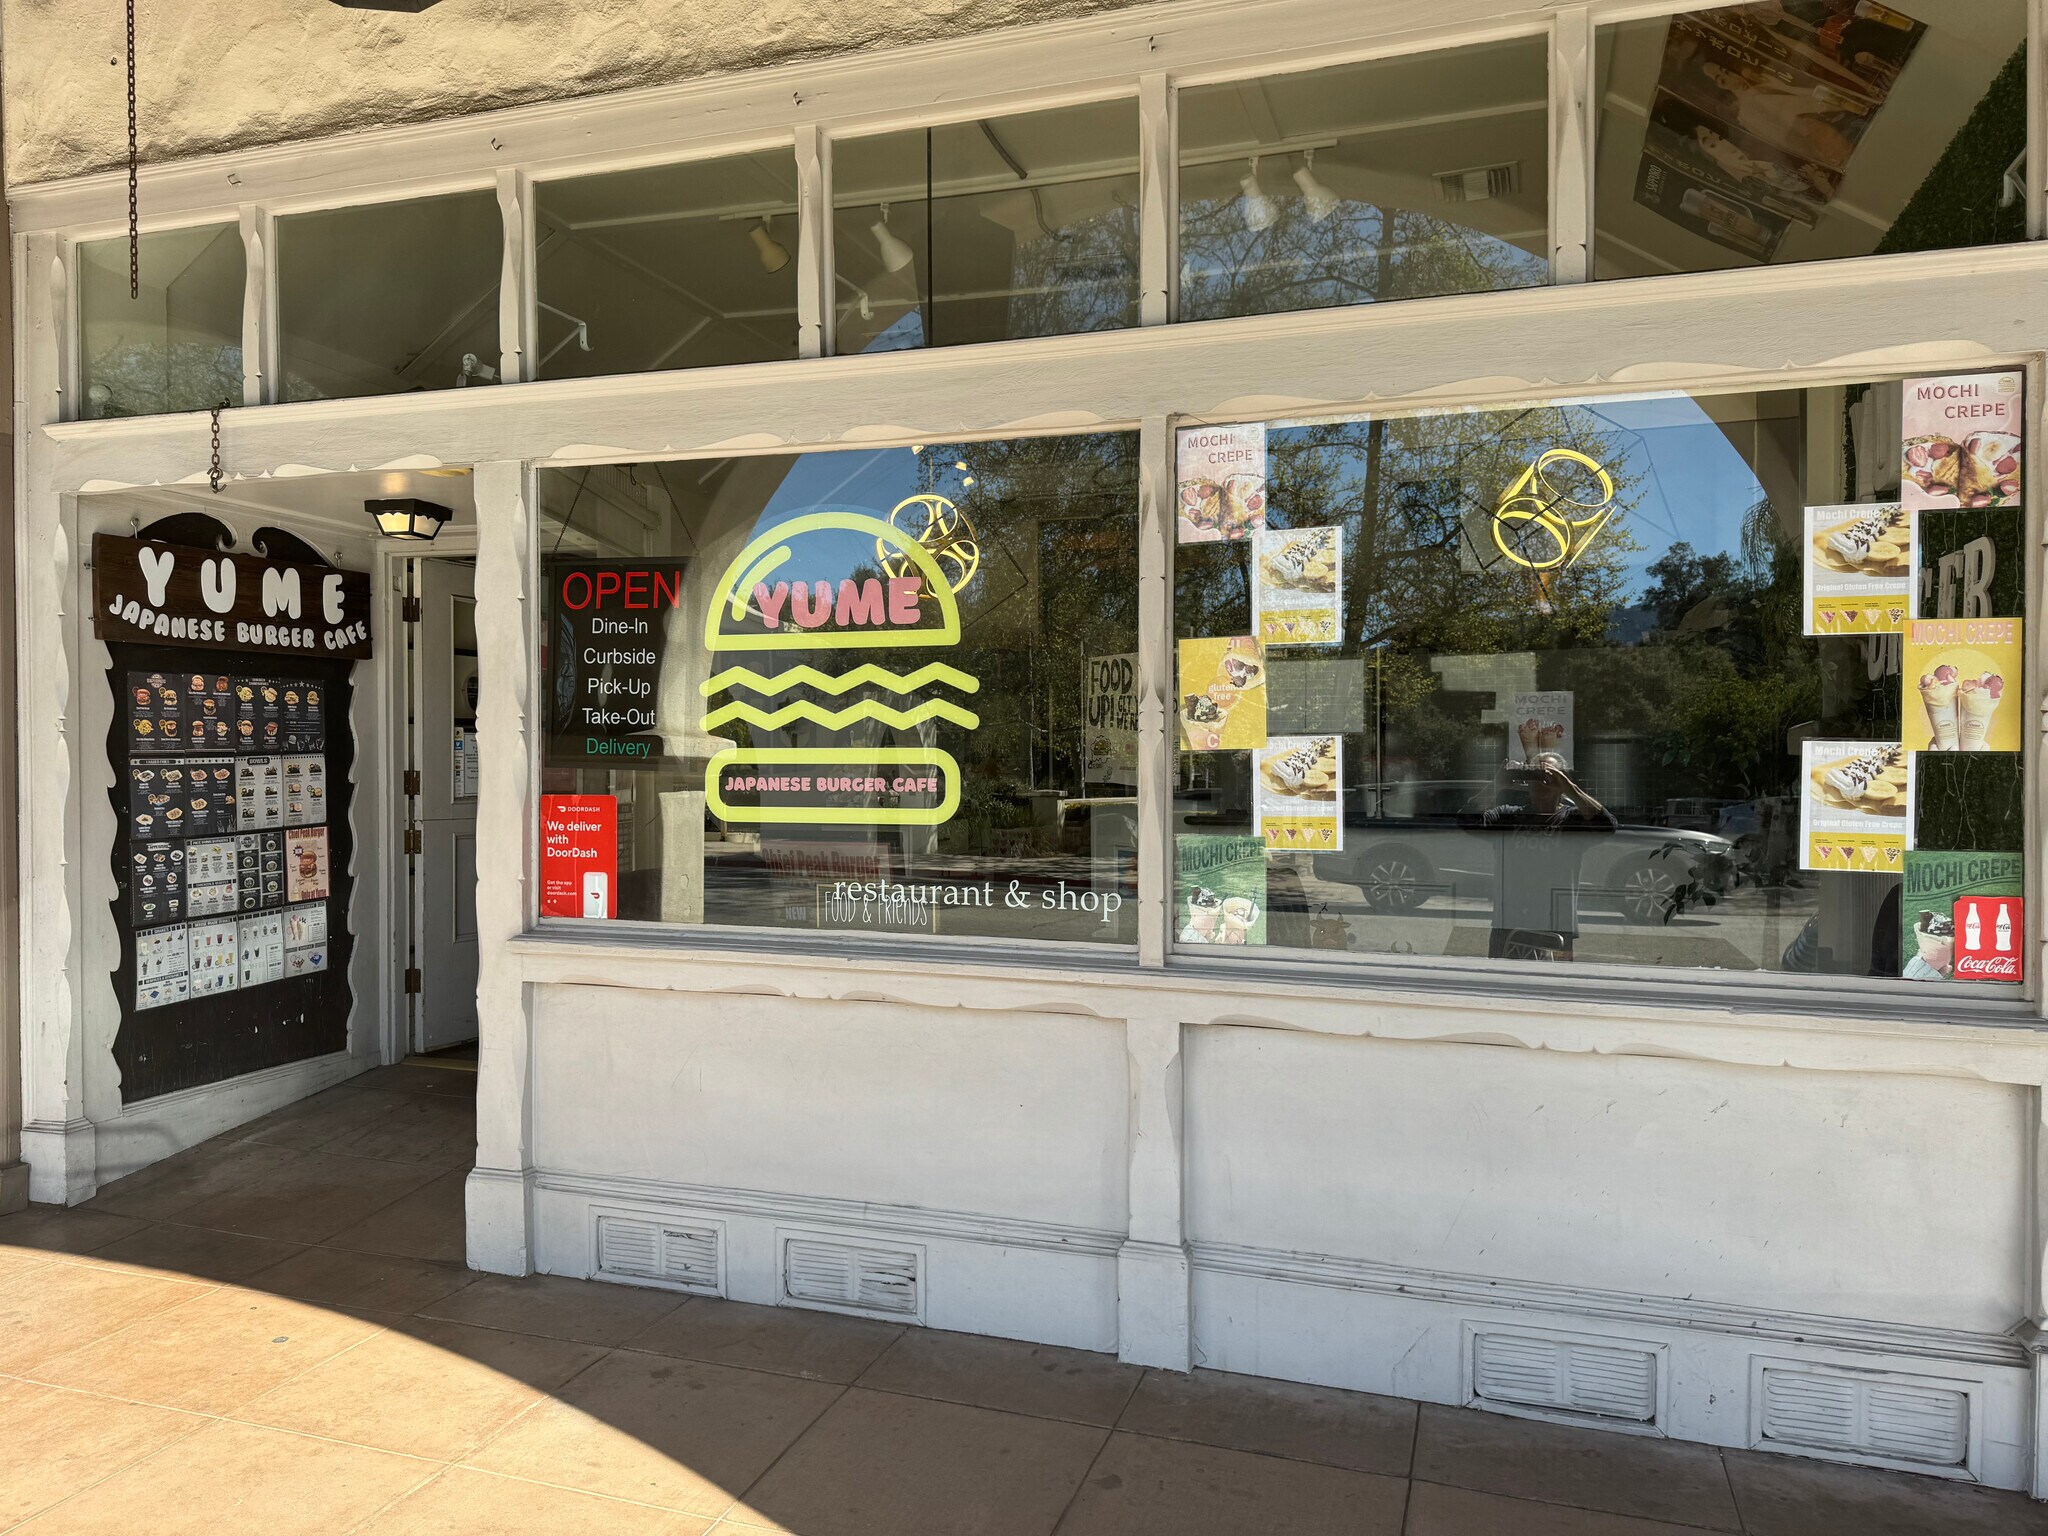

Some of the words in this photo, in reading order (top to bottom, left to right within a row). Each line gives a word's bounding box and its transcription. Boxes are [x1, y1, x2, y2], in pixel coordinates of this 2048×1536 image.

[1645, 164, 1663, 193] SAPPORO
[1917, 383, 1979, 400] MOCHI
[1944, 403, 2006, 419] CREPE
[1188, 433, 1233, 449] MOCHI
[1208, 449, 1253, 464] CREPE
[1816, 510, 1847, 521] Mochi
[138, 546, 345, 625] YUME
[562, 571, 680, 610] OPEN
[753, 577, 921, 628] YUME
[108, 594, 226, 642] JAPANESE
[236, 622, 316, 649] BURGER
[323, 620, 368, 651] CAFE
[591, 617, 649, 635] Dine-In
[1911, 622, 1963, 645] MOCHI
[1965, 622, 2013, 645] CREPE
[583, 648, 656, 665] Curbside
[1091, 658, 1133, 696] FOOD
[587, 678, 651, 699] Pick-Up
[1208, 684, 1236, 694] gluten
[1213, 692, 1231, 701] free
[1514, 695, 1567, 704] MOCHI
[582, 708, 656, 726] Take-Out
[1088, 694, 1115, 729] UP!
[1515, 706, 1566, 716] CREPE
[586, 738, 651, 760] Delivery
[1814, 745, 1845, 756] Mochi
[725, 776, 811, 792] JAPANESE
[816, 777, 886, 793] BURGER
[892, 777, 938, 794] CAFE
[546, 820, 565, 832] We
[566, 821, 602, 832] deliver
[546, 834, 569, 845] with
[546, 847, 598, 858] DoorDash
[1181, 844, 1223, 872] MOCHI
[1907, 861, 1963, 894] MOCHI
[1967, 858, 2021, 882] CREPE
[825, 891, 856, 923] FOOD
[833, 879, 994, 908] restaurant
[1004, 879, 1031, 909] &
[1042, 880, 1122, 922] shop
[1957, 955, 2018, 974] Coca-Cola
